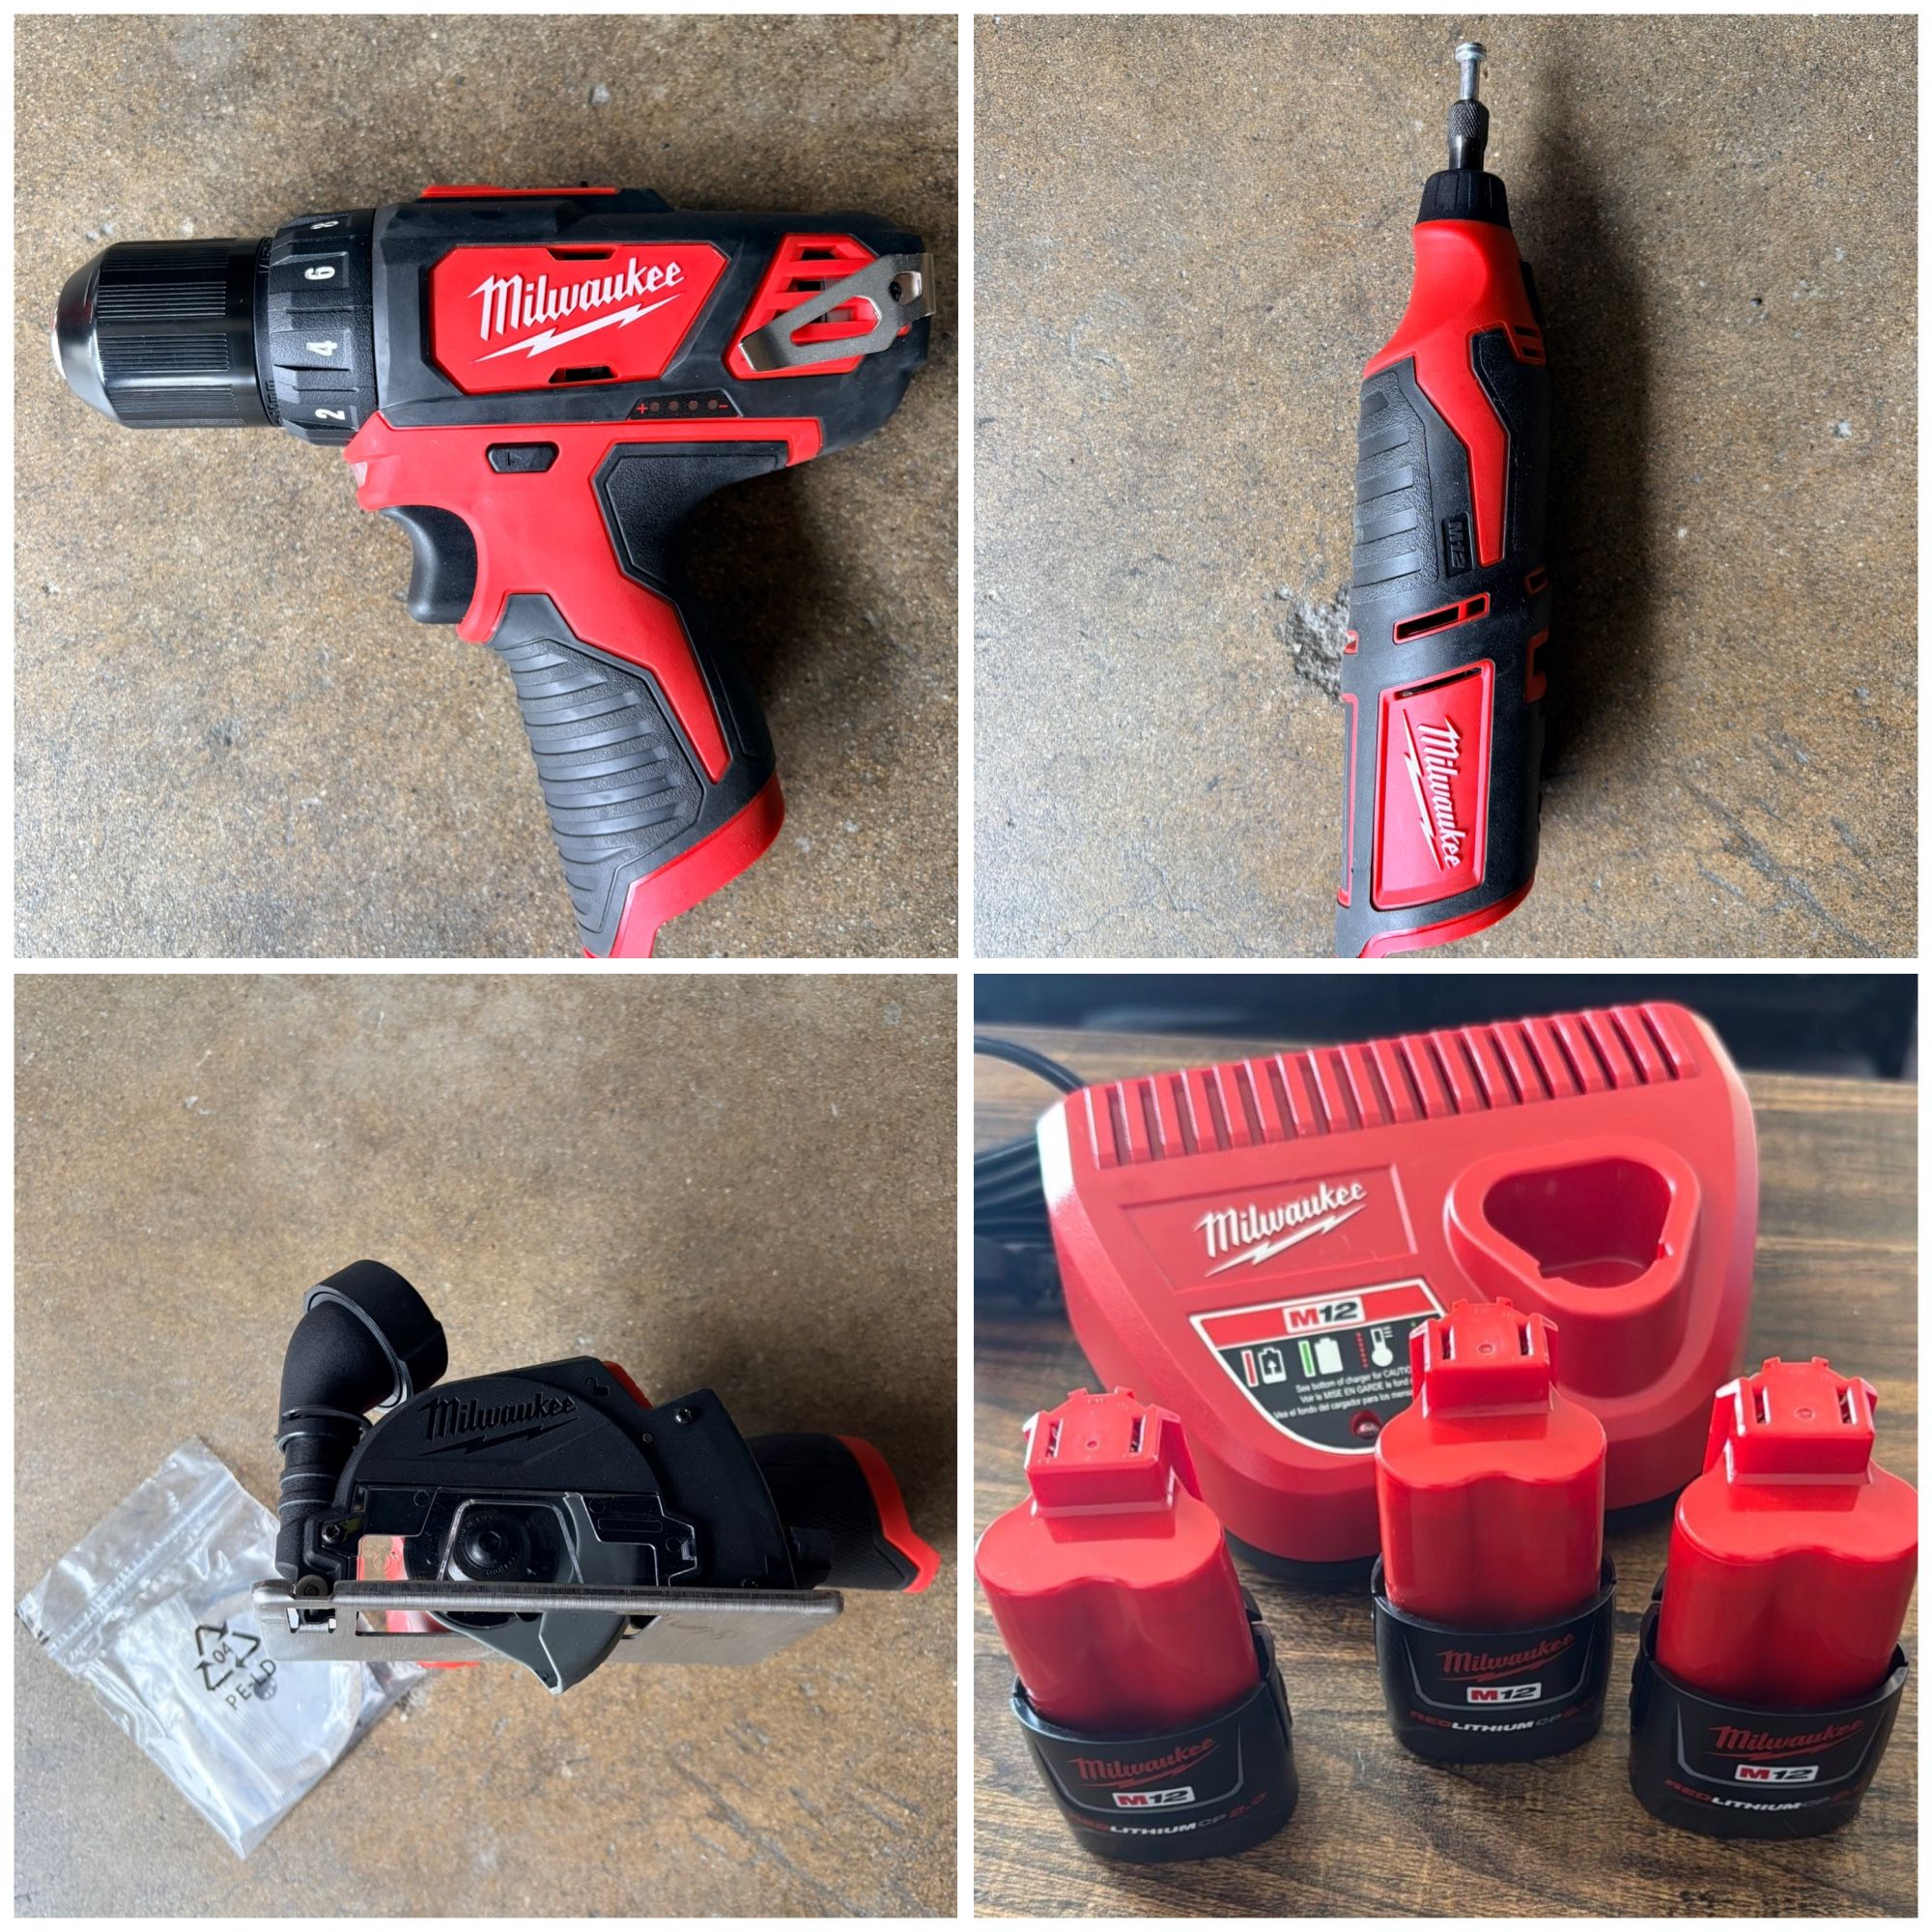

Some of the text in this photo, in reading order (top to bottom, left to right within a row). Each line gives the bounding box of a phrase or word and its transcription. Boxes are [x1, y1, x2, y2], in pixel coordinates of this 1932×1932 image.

[304, 266, 335, 280] 6
[467, 257, 686, 341] Milwaukee
[305, 340, 338, 356] 4
[315, 409, 345, 420] 2
[1417, 715, 1466, 868] Milwaukee
[1193, 1181, 1367, 1258] Milwaukee
[1290, 1302, 1358, 1329] M12
[1323, 1389, 1344, 1399] MISE
[1344, 1387, 1356, 1396] EN
[1356, 1381, 1385, 1394] GARDE
[1345, 1375, 1371, 1384] charger
[417, 1393, 577, 1442] Milwaukee
[213, 1641, 234, 1663] 04
[1435, 1634, 1576, 1673] Milwaukee
[225, 1659, 276, 1710] PE-LD
[1470, 1687, 1537, 1700] M12
[1708, 1719, 1864, 1750] Milwaukee
[1066, 1738, 1216, 1780] Milwaukee
[1740, 1768, 1814, 1780] M12
[1117, 1789, 1189, 1805] M12
